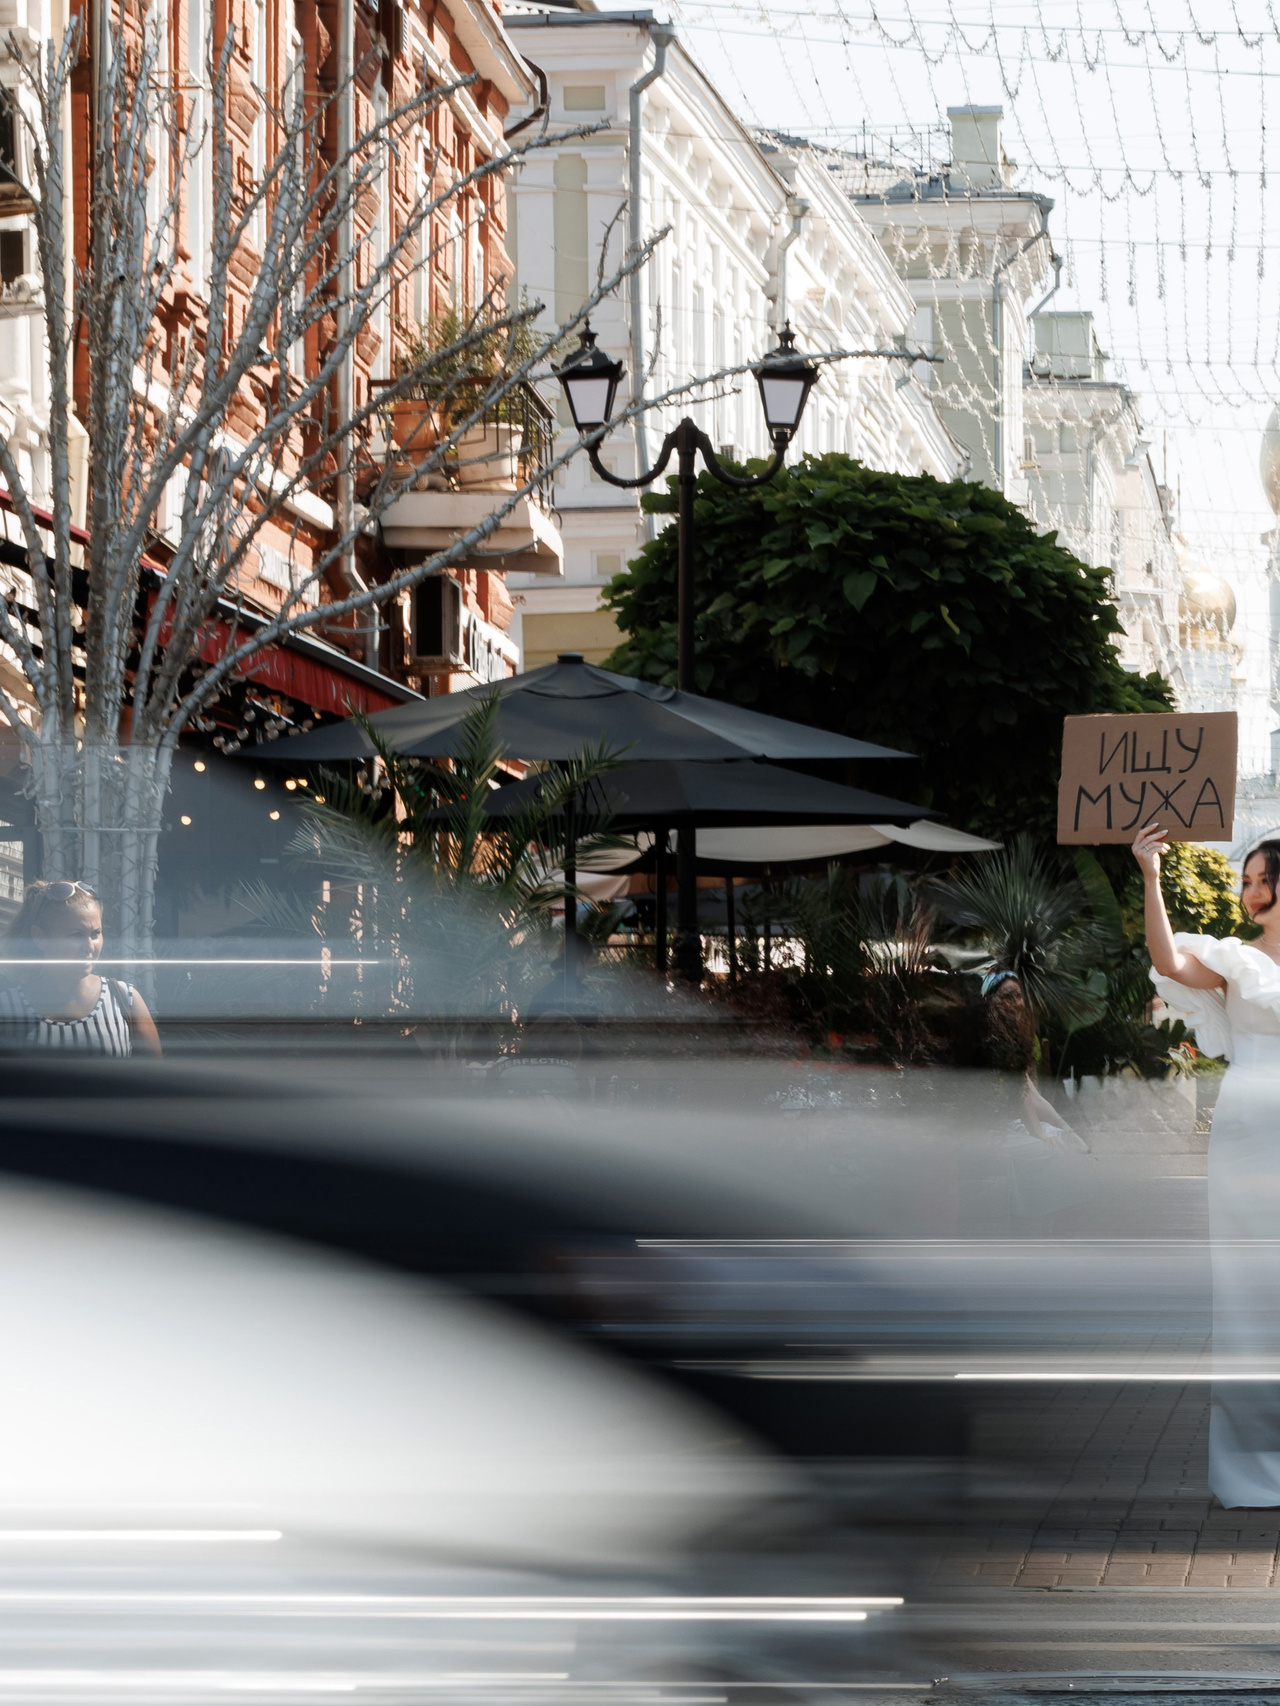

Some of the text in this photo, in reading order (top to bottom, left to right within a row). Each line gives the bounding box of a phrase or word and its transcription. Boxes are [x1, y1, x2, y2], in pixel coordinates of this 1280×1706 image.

[1099, 726, 1204, 776] ИЩУ
[1073, 777, 1225, 832] МУЖА
[497, 1057, 577, 1073] PERFECTION
